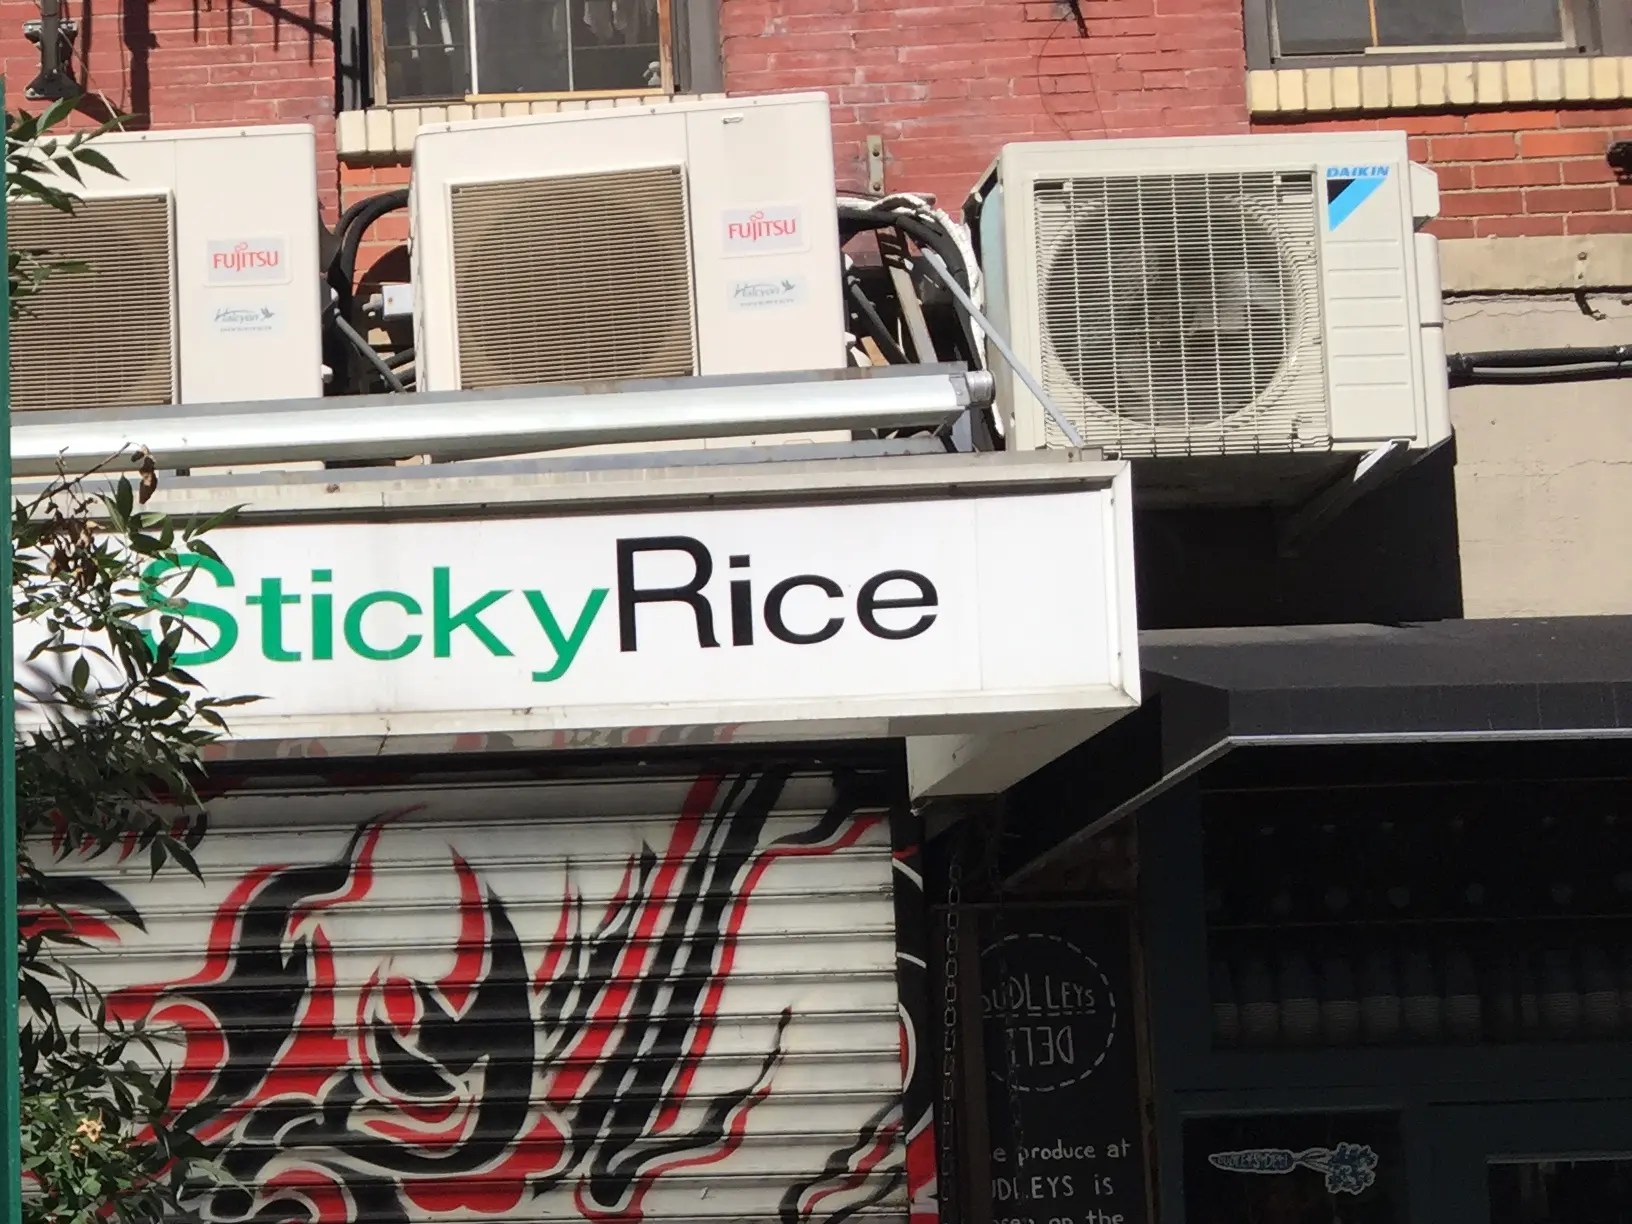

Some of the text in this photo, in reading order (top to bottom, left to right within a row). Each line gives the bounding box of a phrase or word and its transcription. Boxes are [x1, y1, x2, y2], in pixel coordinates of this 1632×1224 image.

[1326, 165, 1391, 178] DAIKIN
[728, 211, 796, 242] FUJITSU
[213, 242, 280, 272] FUJITSU
[1018, 1138, 1097, 1168] produce
[1106, 1138, 1131, 1159] at
[1093, 1173, 1114, 1196] is
